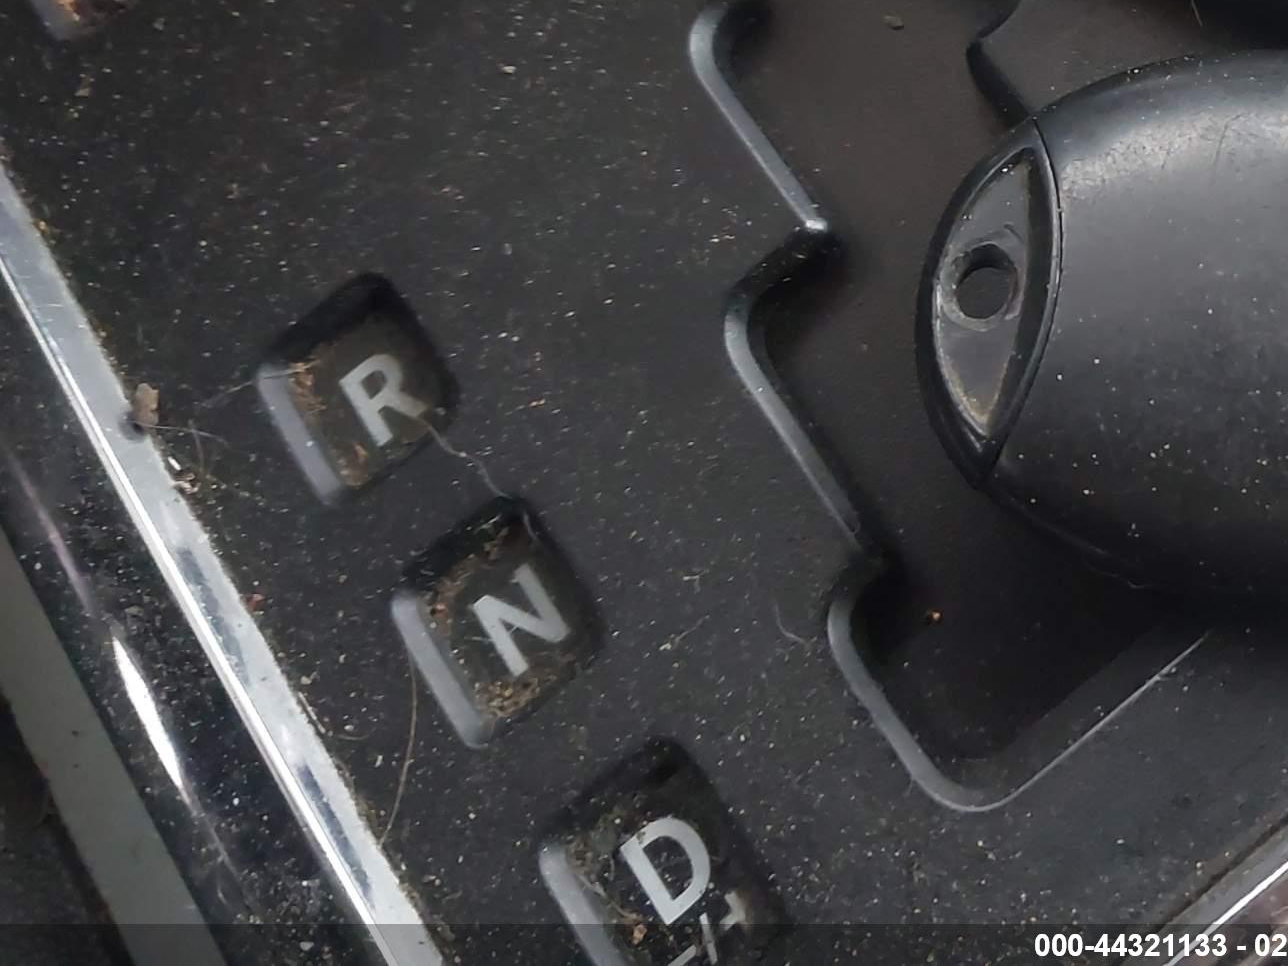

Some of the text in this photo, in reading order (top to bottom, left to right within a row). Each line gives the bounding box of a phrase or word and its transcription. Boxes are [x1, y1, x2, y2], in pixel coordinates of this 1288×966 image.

[338, 353, 431, 447] R
[472, 564, 571, 678] N
[619, 815, 712, 926] D
